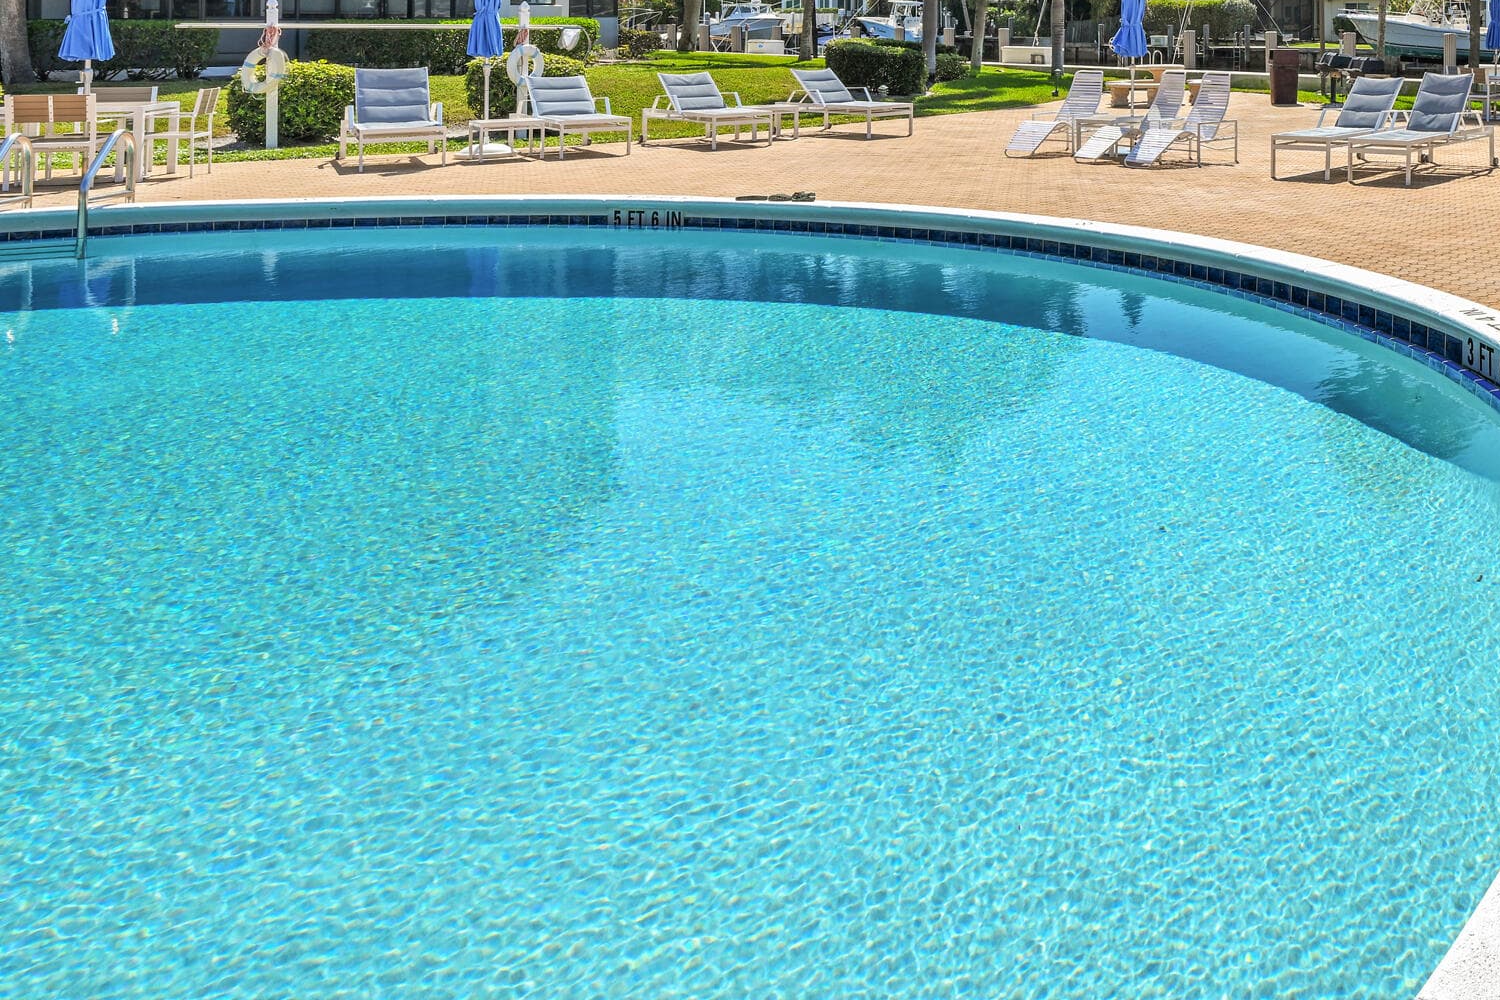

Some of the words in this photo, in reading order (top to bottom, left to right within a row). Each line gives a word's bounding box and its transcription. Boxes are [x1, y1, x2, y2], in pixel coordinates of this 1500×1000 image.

[613, 210, 622, 227] 5
[628, 210, 645, 227] FT
[651, 210, 660, 227] 6
[666, 210, 682, 228] IN
[1467, 337, 1474, 366] 3
[1479, 342, 1495, 377] FT
